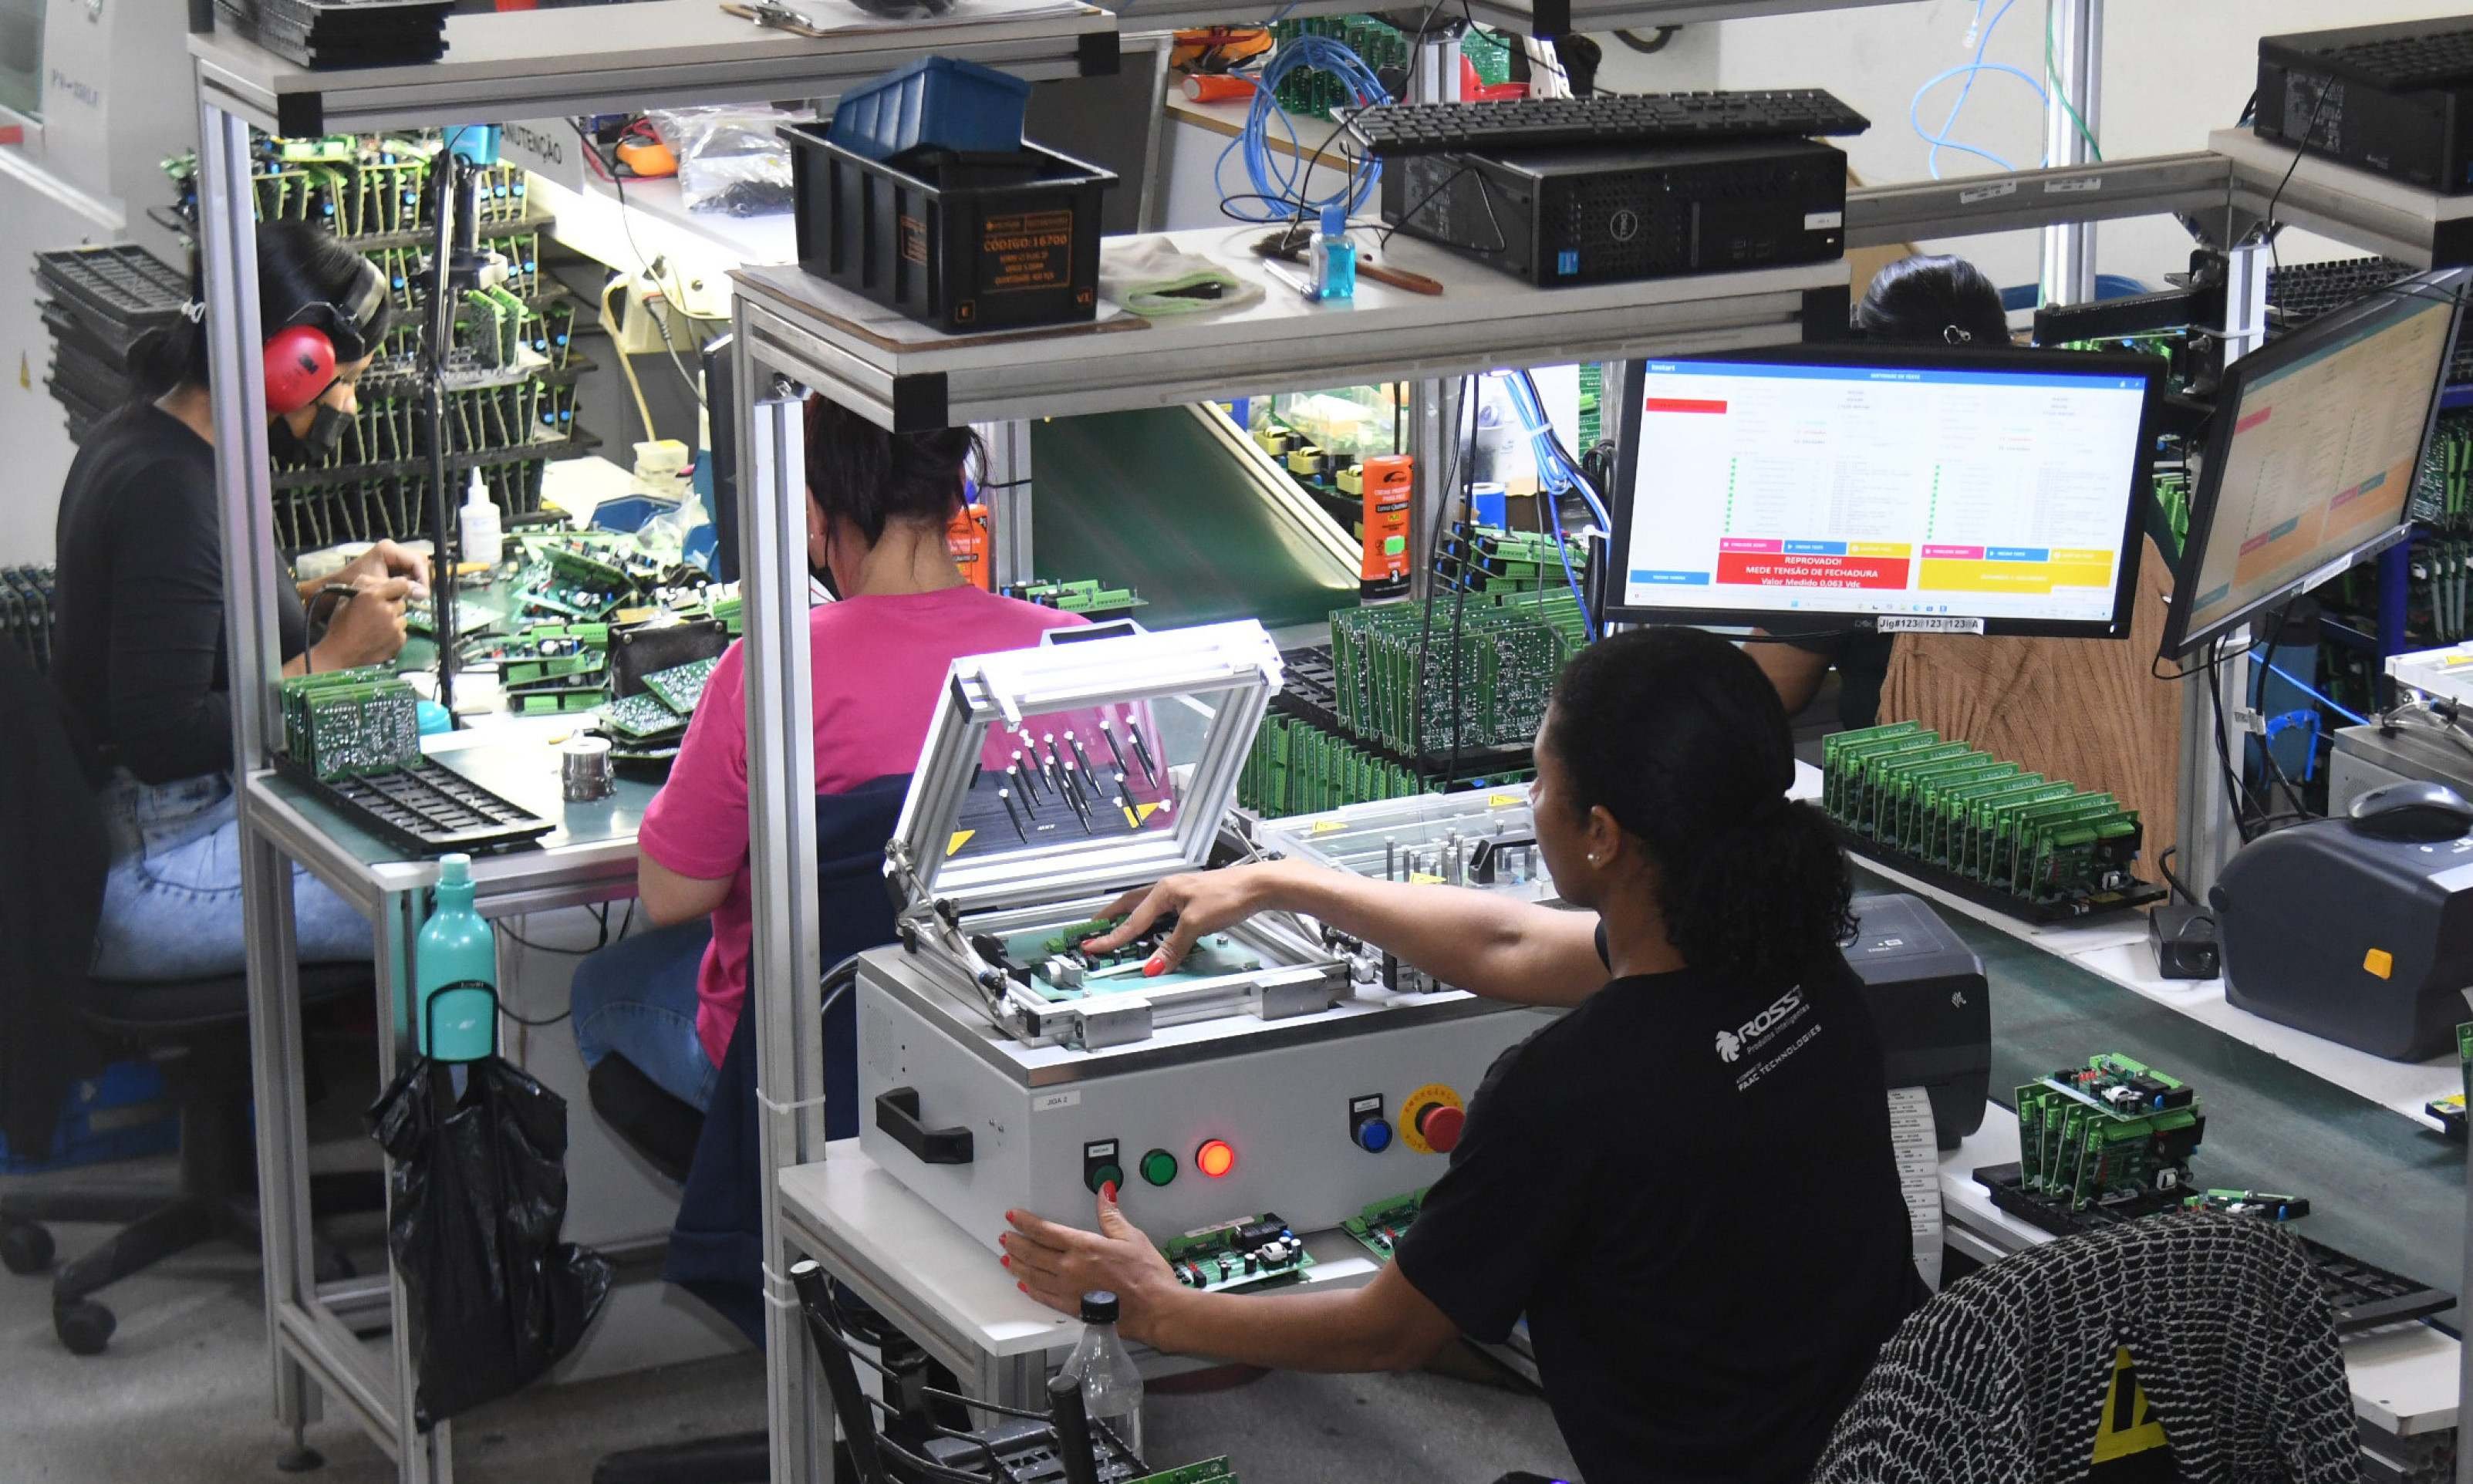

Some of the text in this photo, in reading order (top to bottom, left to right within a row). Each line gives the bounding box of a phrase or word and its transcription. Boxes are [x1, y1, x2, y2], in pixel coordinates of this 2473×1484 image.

[501, 123, 562, 164] NUTENÇÃO
[1785, 556, 1843, 565] REPROVADO!
[1392, 570, 1399, 582] 3
[1746, 565, 1879, 578] MEDE TENSÃO DE FECHADURA
[1761, 578, 1861, 589] Valor Medido 0,063 Vdc
[1736, 983, 1803, 1044] ROSS
[1759, 1023, 1822, 1075] TECHNOLOGIES
